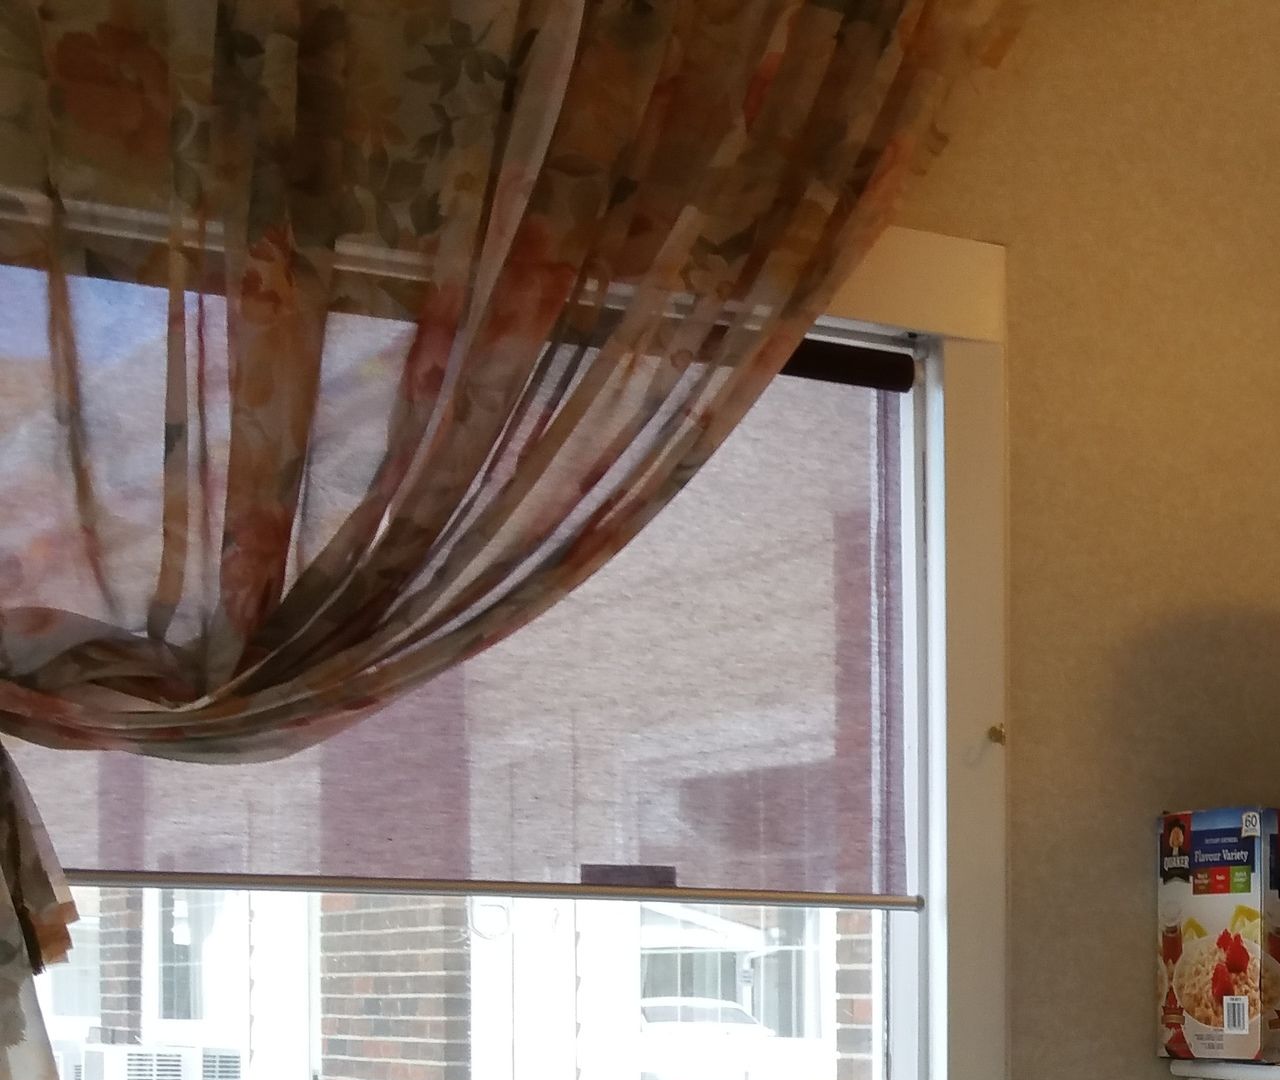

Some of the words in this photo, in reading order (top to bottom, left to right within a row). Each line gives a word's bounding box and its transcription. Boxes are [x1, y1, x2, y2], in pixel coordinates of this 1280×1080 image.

[1244, 814, 1258, 828] 60
[1194, 850, 1221, 862] Flavour
[1222, 849, 1249, 862] Variety
[1163, 855, 1190, 871] QUAKER
